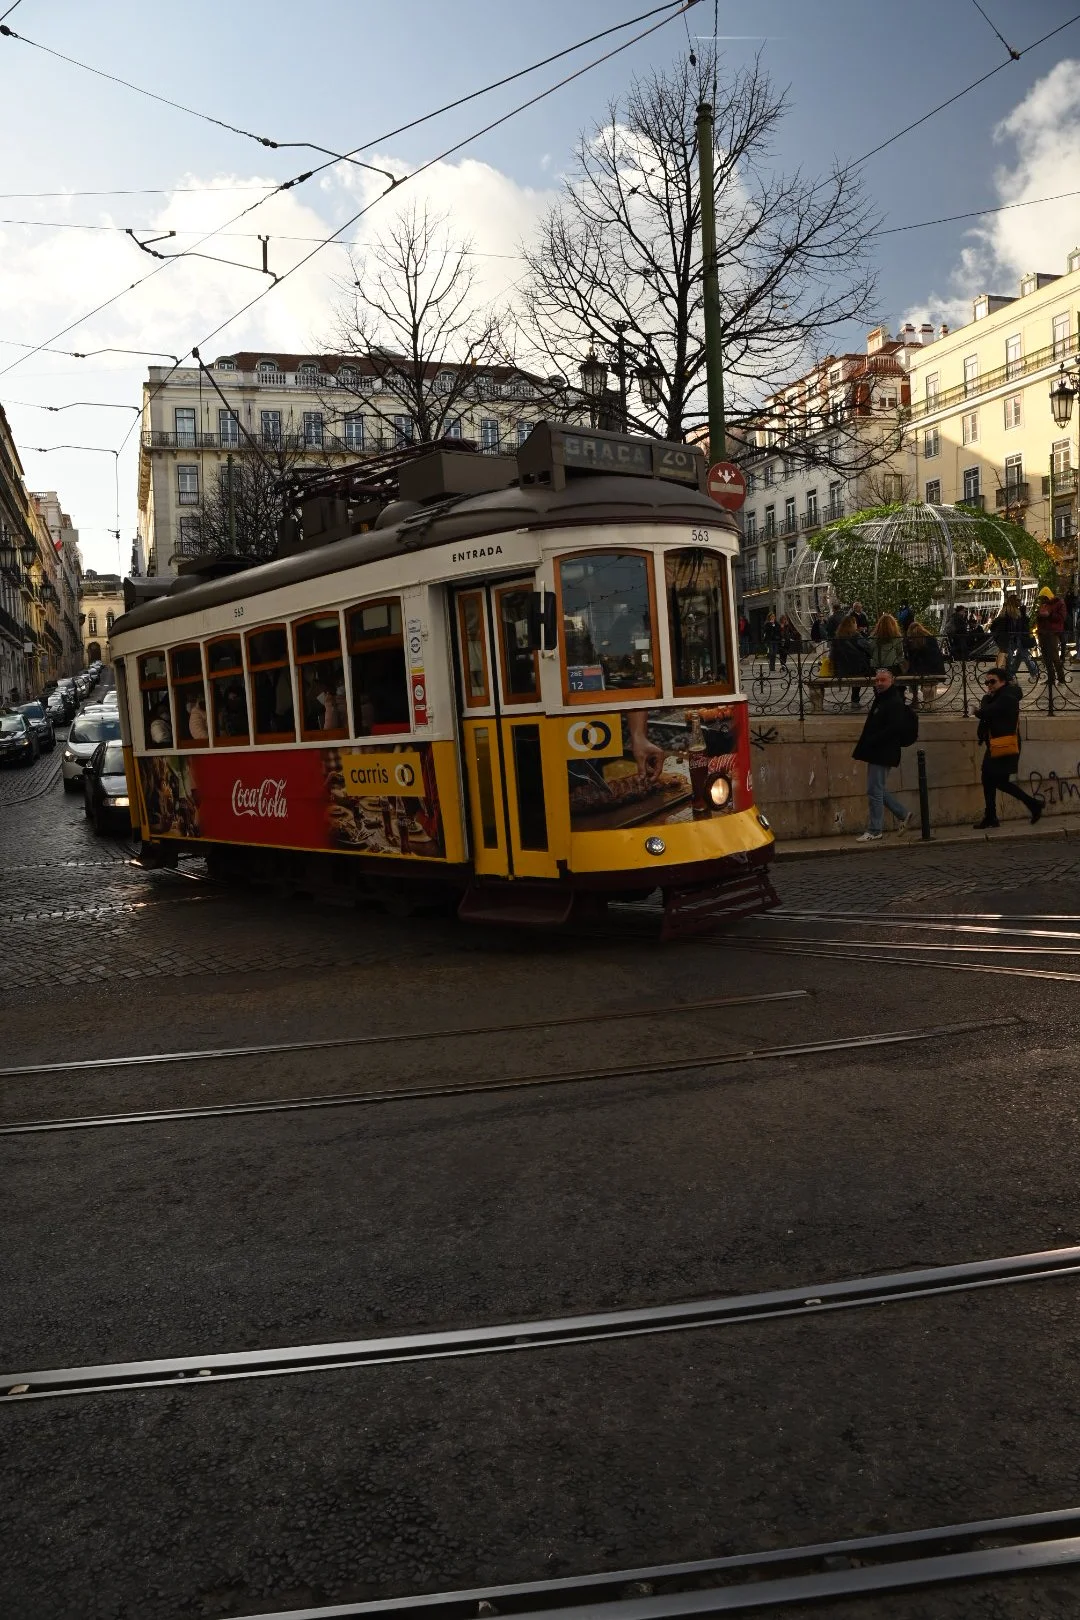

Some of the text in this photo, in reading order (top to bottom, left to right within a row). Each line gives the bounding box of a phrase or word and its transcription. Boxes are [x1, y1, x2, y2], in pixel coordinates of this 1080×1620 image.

[692, 529, 709, 542] 563
[452, 545, 503, 563] ENTRADA
[571, 681, 584, 690] 12
[350, 763, 389, 784] carris
[232, 778, 288, 818] Coca-Cola
